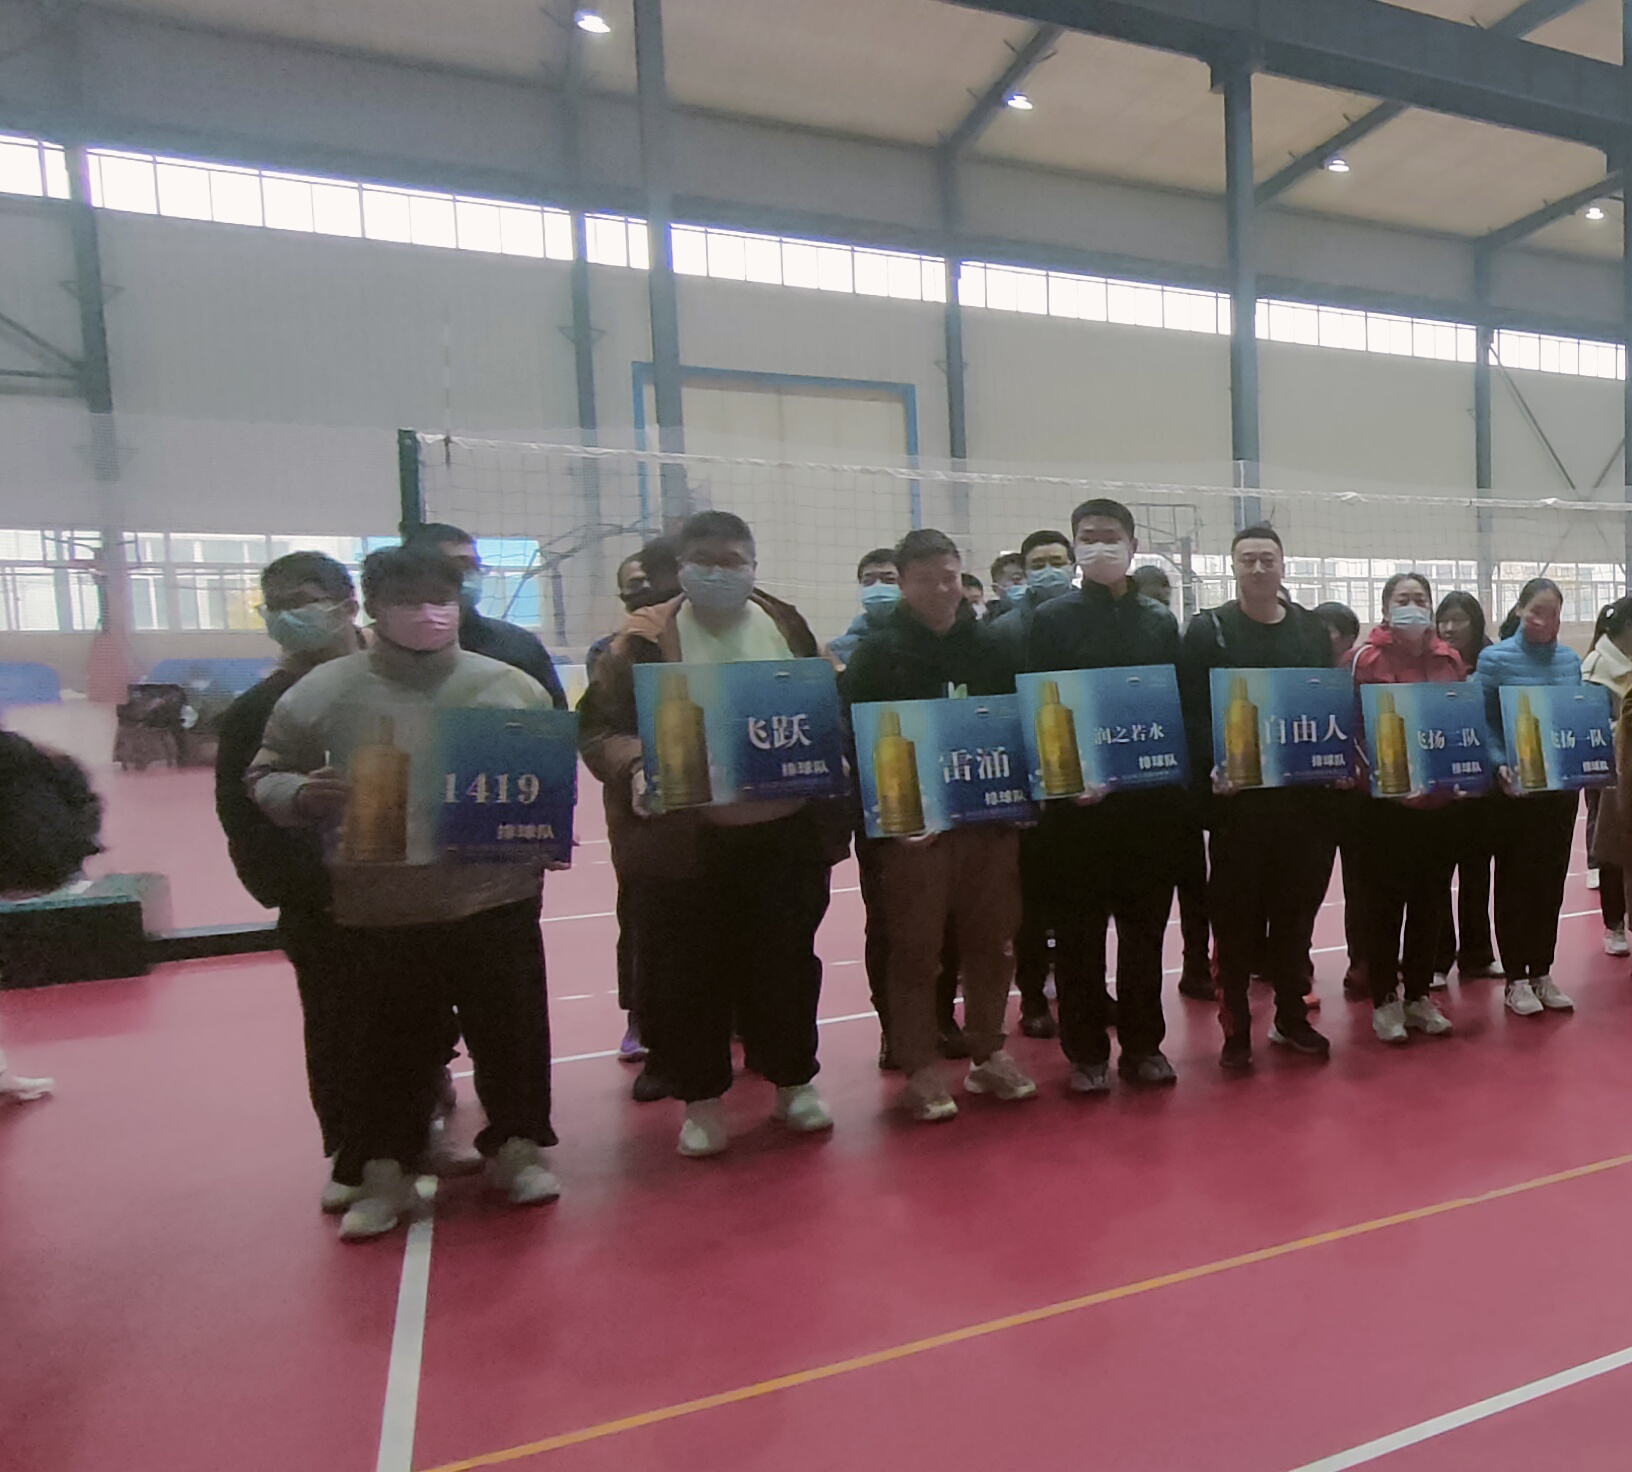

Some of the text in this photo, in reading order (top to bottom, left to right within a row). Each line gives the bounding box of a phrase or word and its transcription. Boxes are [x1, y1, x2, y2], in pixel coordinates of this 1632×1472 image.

[747, 713, 812, 750] 飞跃
[1094, 722, 1165, 746] 润之若水
[1264, 714, 1348, 745] 自由人
[1416, 728, 1481, 750] 飞扬二队
[1551, 728, 1607, 749] 飞扬一队
[781, 759, 830, 777] 排球队
[1139, 753, 1178, 770] 排球队
[443, 772, 541, 805] 1419
[984, 789, 1027, 806] 排球队
